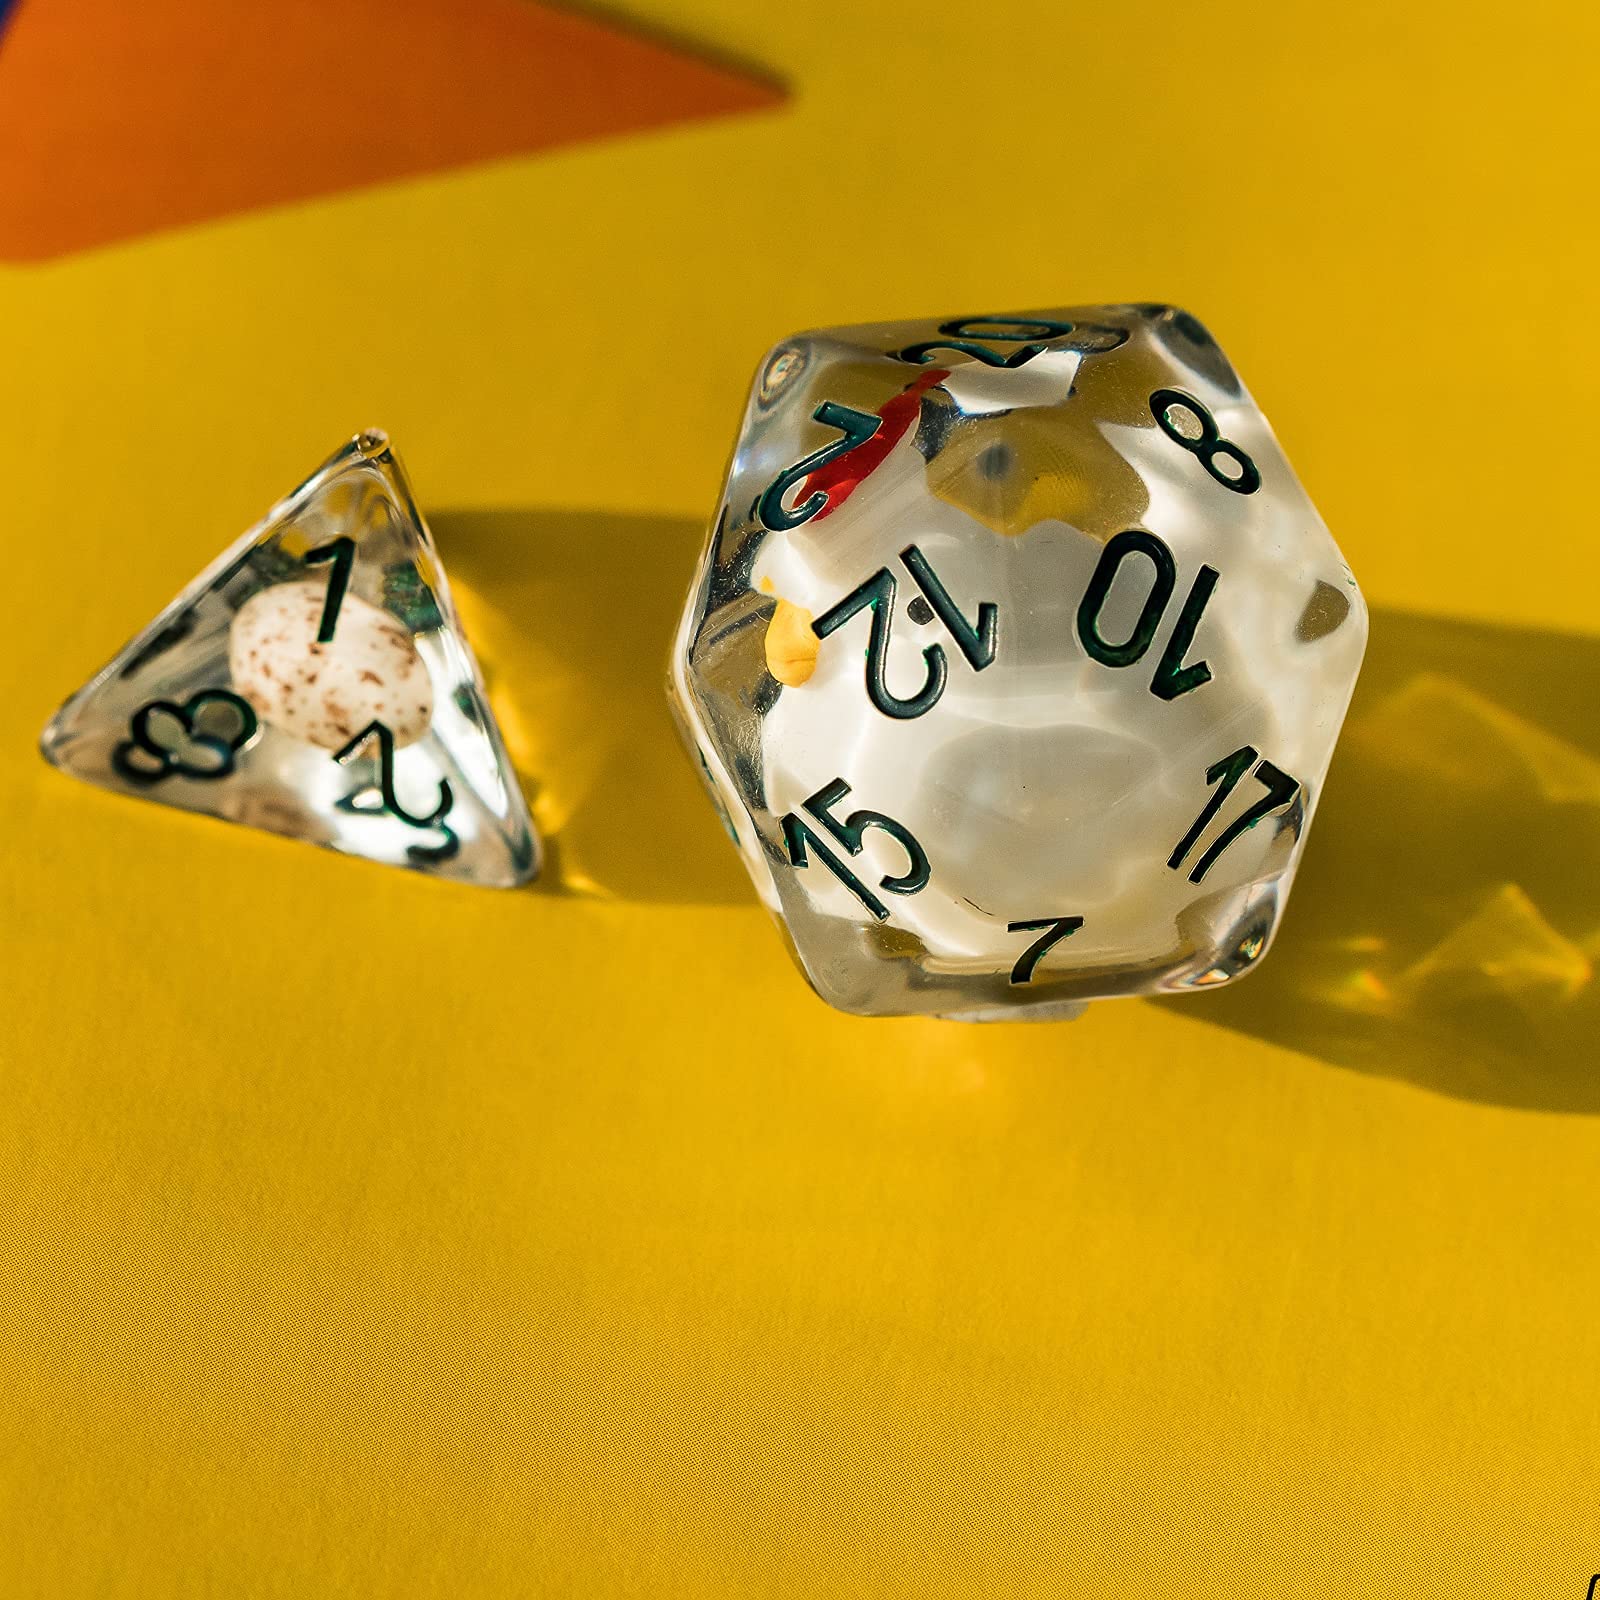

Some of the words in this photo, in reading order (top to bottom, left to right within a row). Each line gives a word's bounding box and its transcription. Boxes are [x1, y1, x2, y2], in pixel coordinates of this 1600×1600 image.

[897, 315, 1074, 368] 20
[758, 400, 883, 531] 2
[1148, 388, 1262, 496] 8
[305, 536, 354, 642] 1
[811, 544, 999, 721] 12
[1076, 529, 1221, 701] 10
[780, 777, 932, 922] 15
[1167, 745, 1301, 885] 17
[1006, 916, 1084, 985] 7
